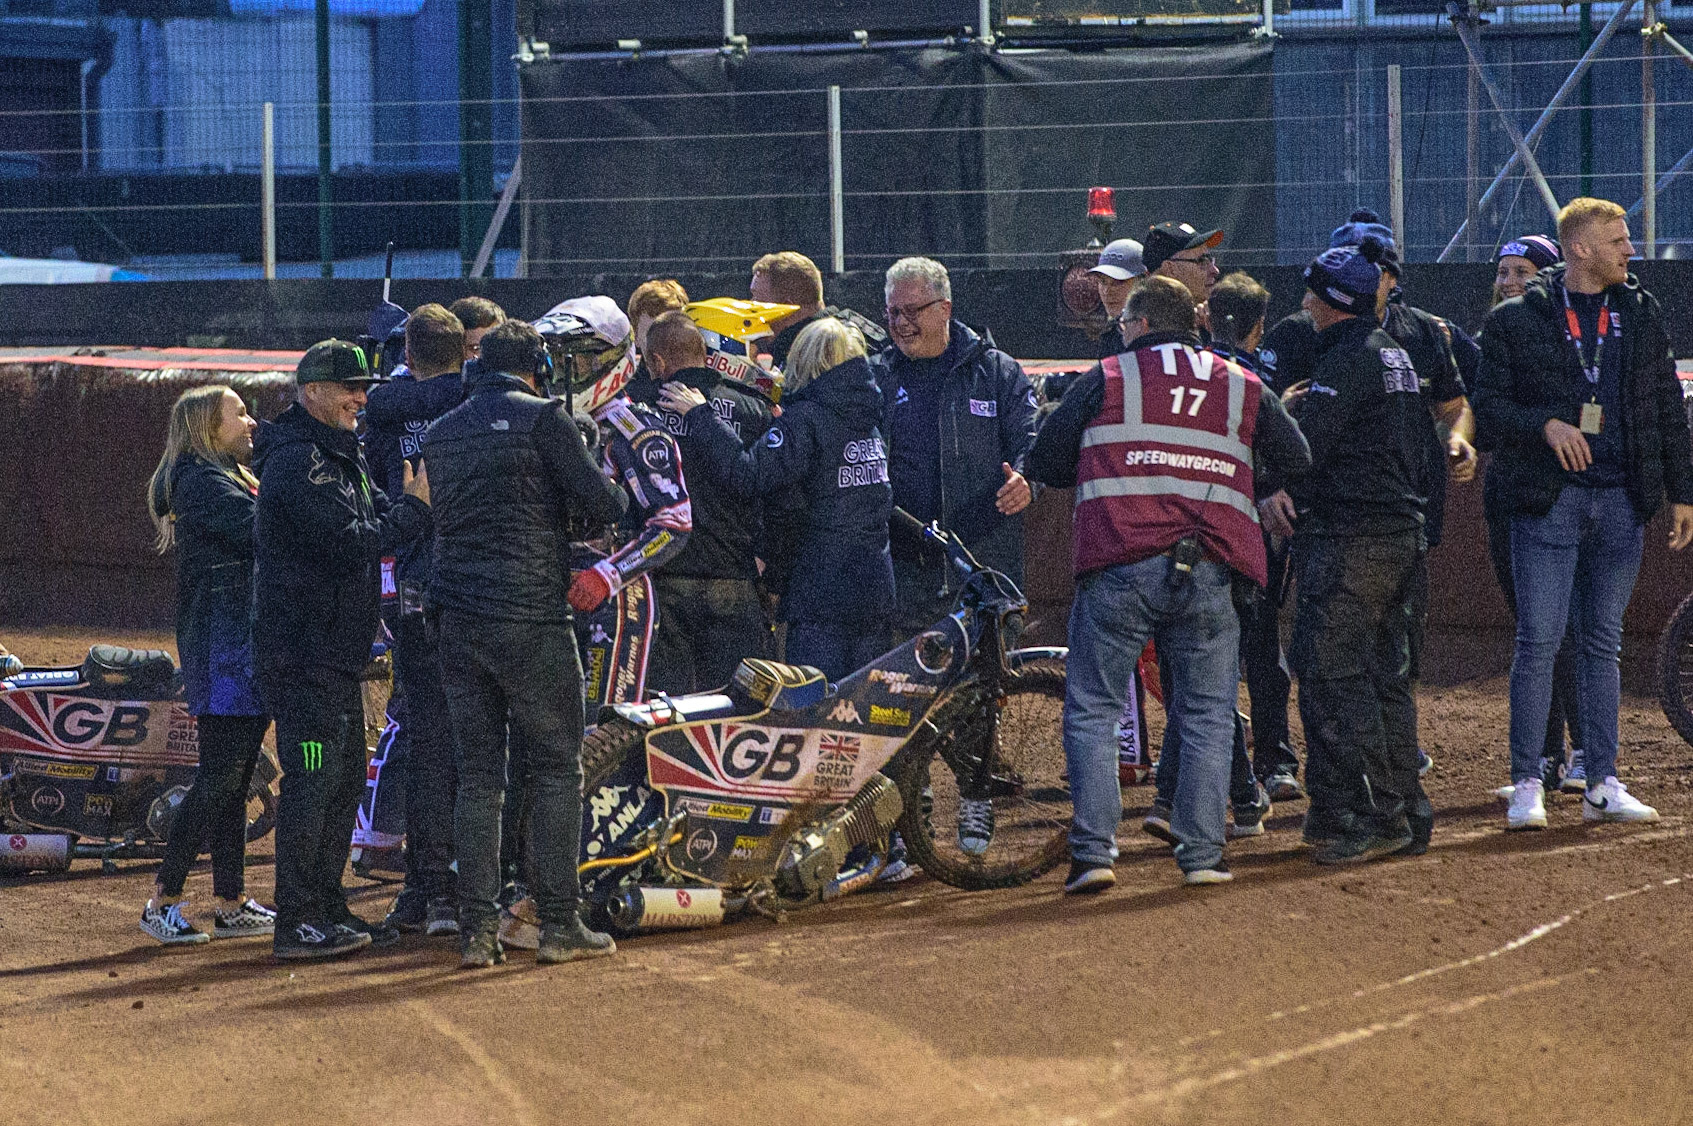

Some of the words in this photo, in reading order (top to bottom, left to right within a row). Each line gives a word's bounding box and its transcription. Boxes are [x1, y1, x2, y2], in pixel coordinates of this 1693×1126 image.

[717, 357, 747, 379] Bull
[1151, 342, 1213, 381] TV
[1170, 386, 1207, 417] 17
[1125, 450, 1236, 478] SPEEDWAYGP.COM
[53, 702, 149, 746] GB
[722, 729, 804, 781] GB
[816, 762, 855, 776] GREAT
[813, 775, 851, 787] BRITAIN
[711, 804, 748, 817] Mobility
